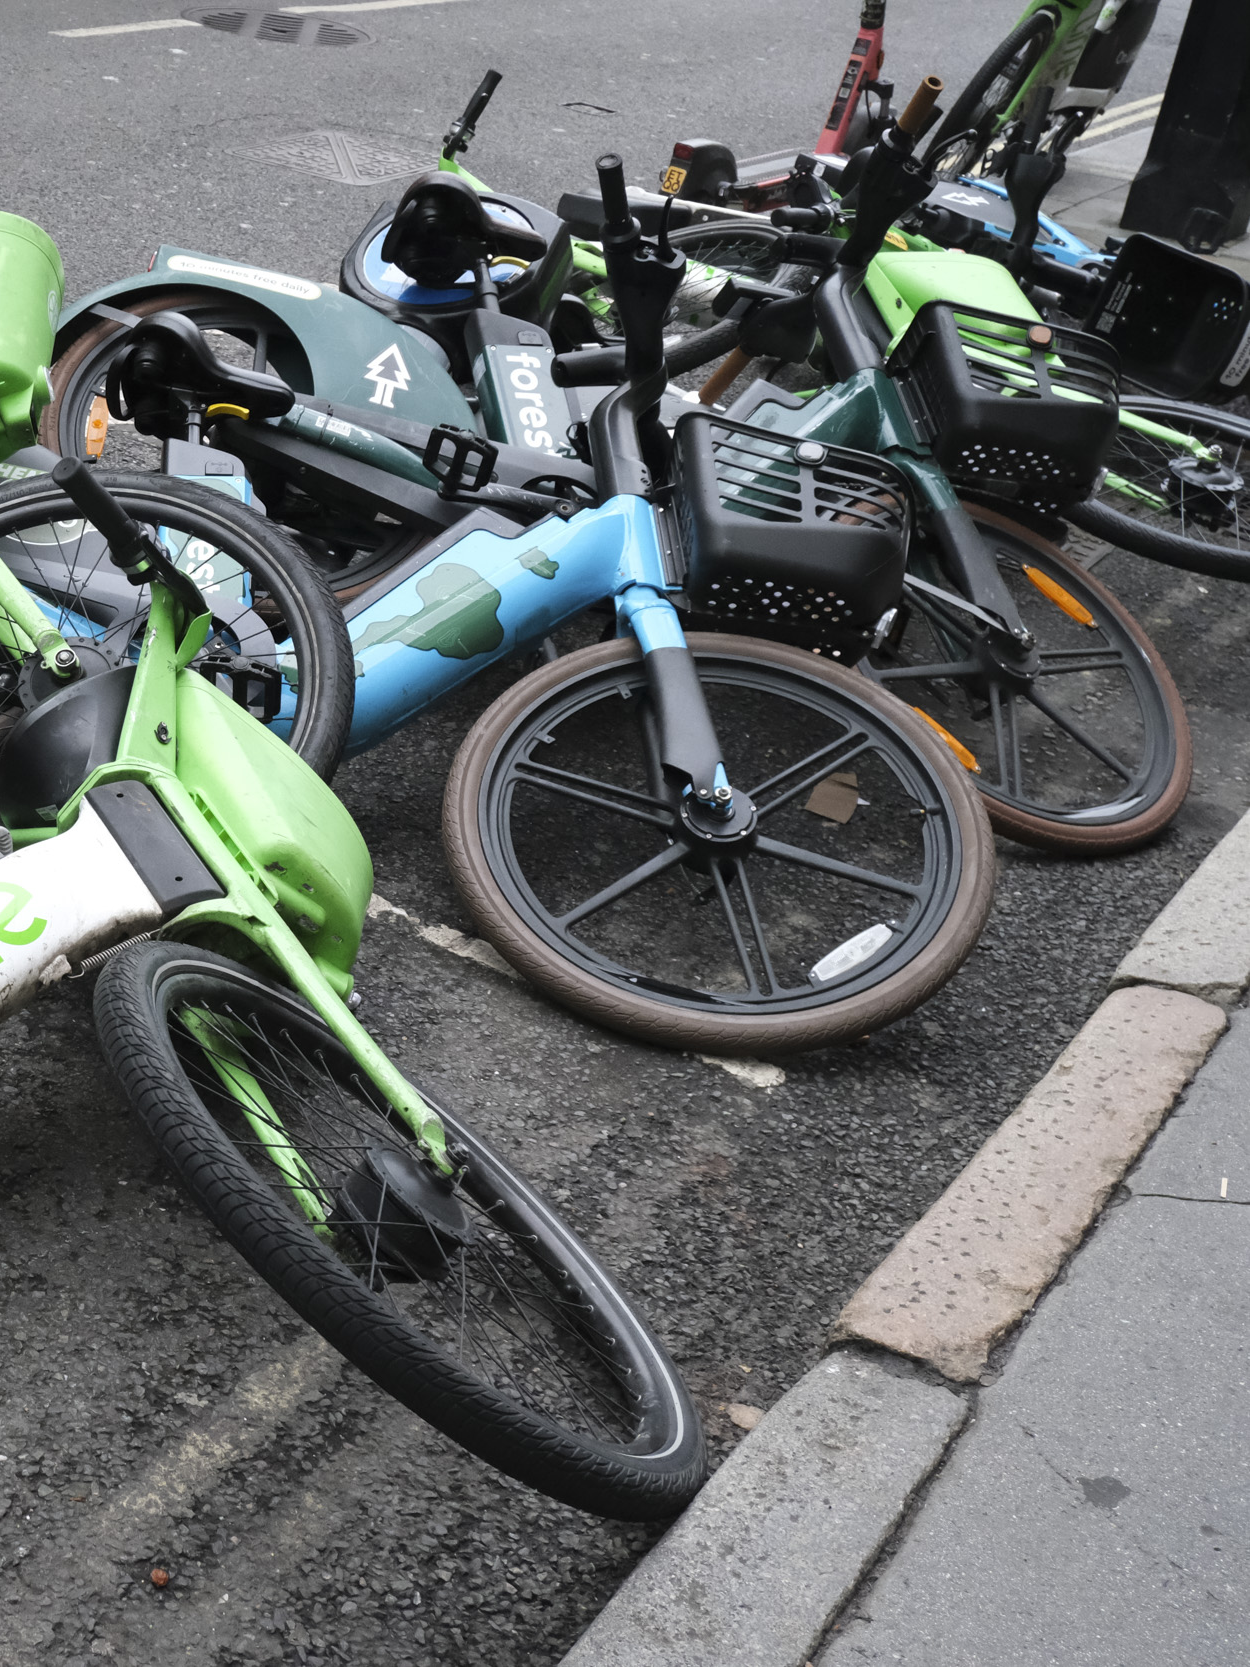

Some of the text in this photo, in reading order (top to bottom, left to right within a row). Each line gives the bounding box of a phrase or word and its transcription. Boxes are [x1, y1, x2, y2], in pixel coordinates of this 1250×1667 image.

[199, 265, 249, 279] minutes
[253, 273, 278, 286] free
[281, 281, 311, 295] daily
